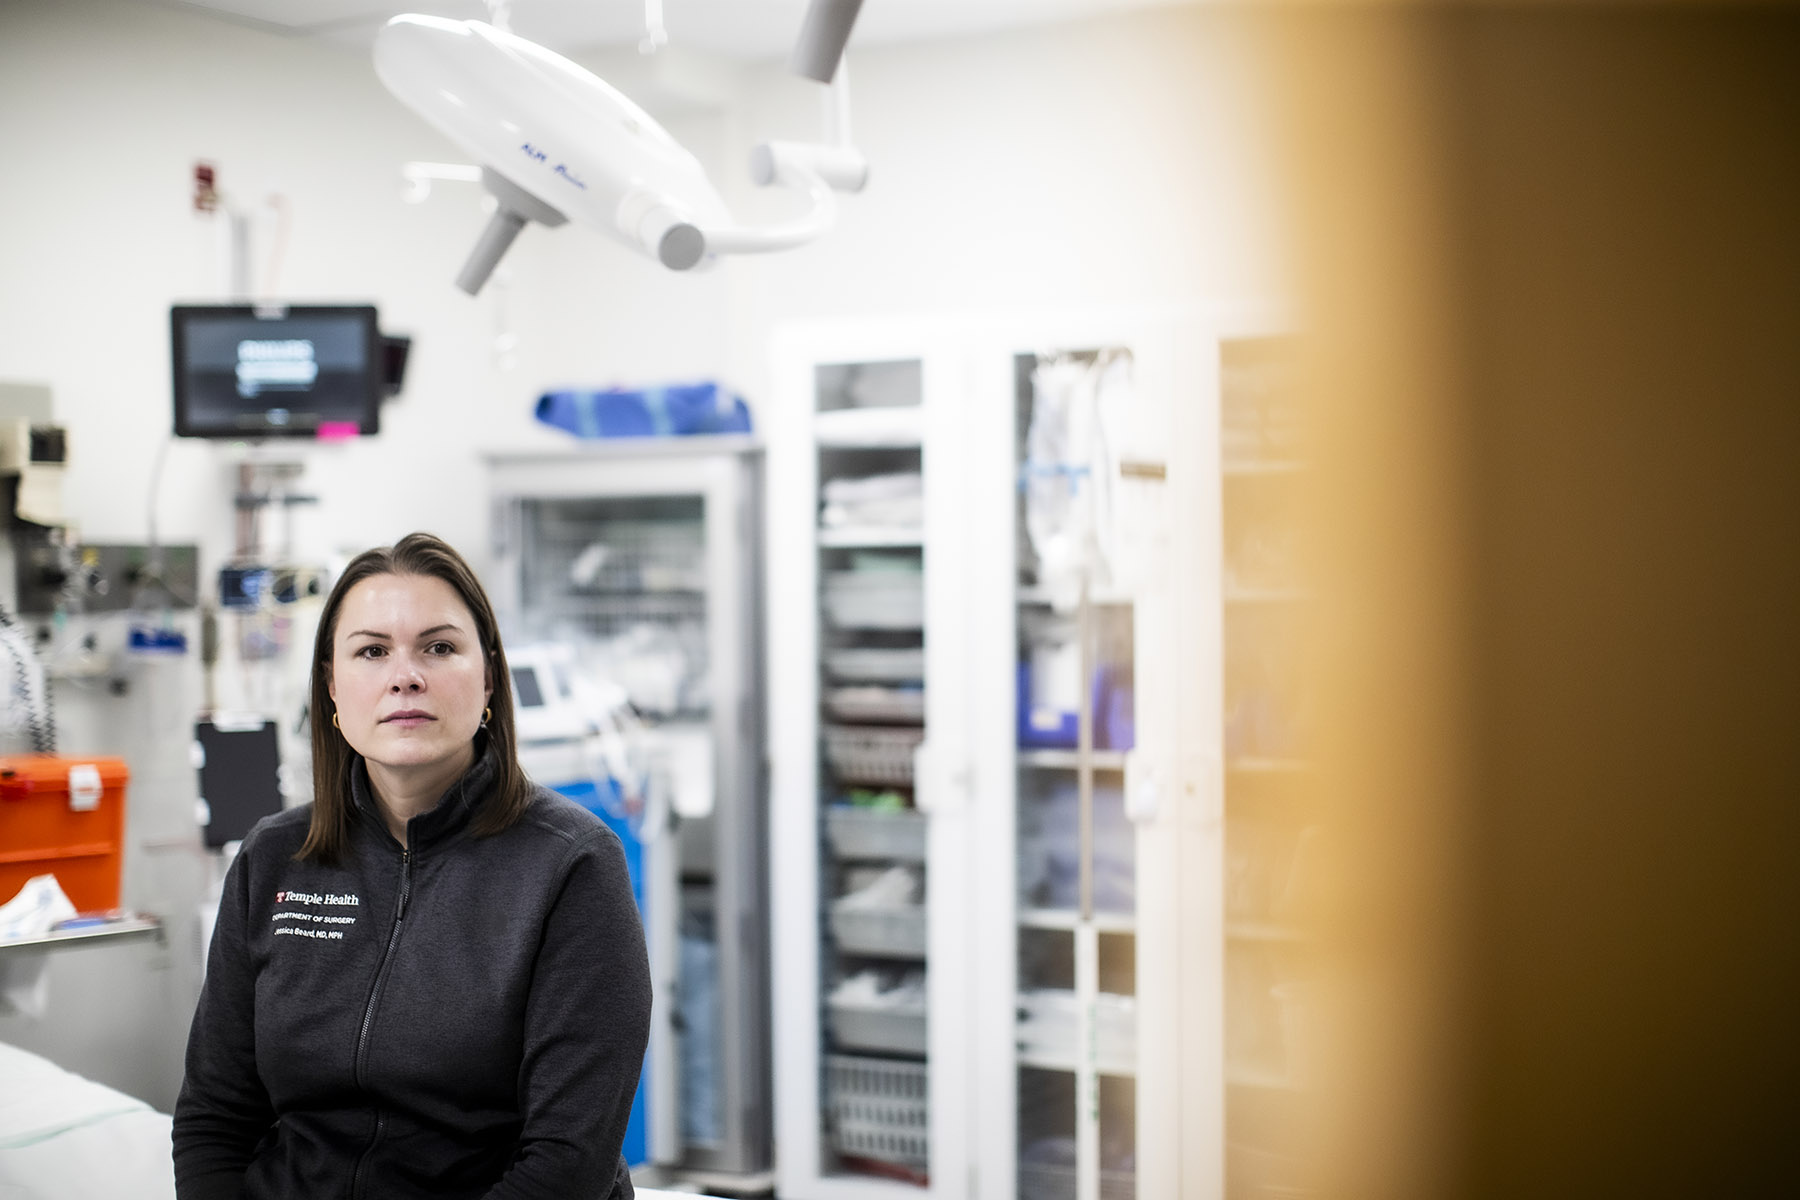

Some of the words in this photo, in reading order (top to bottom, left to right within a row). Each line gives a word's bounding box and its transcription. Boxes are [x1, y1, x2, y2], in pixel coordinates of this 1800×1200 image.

[284, 891, 323, 905] Temple
[323, 893, 359, 906] Health
[323, 916, 356, 925] SURGERY
[328, 931, 343, 940] MPH
